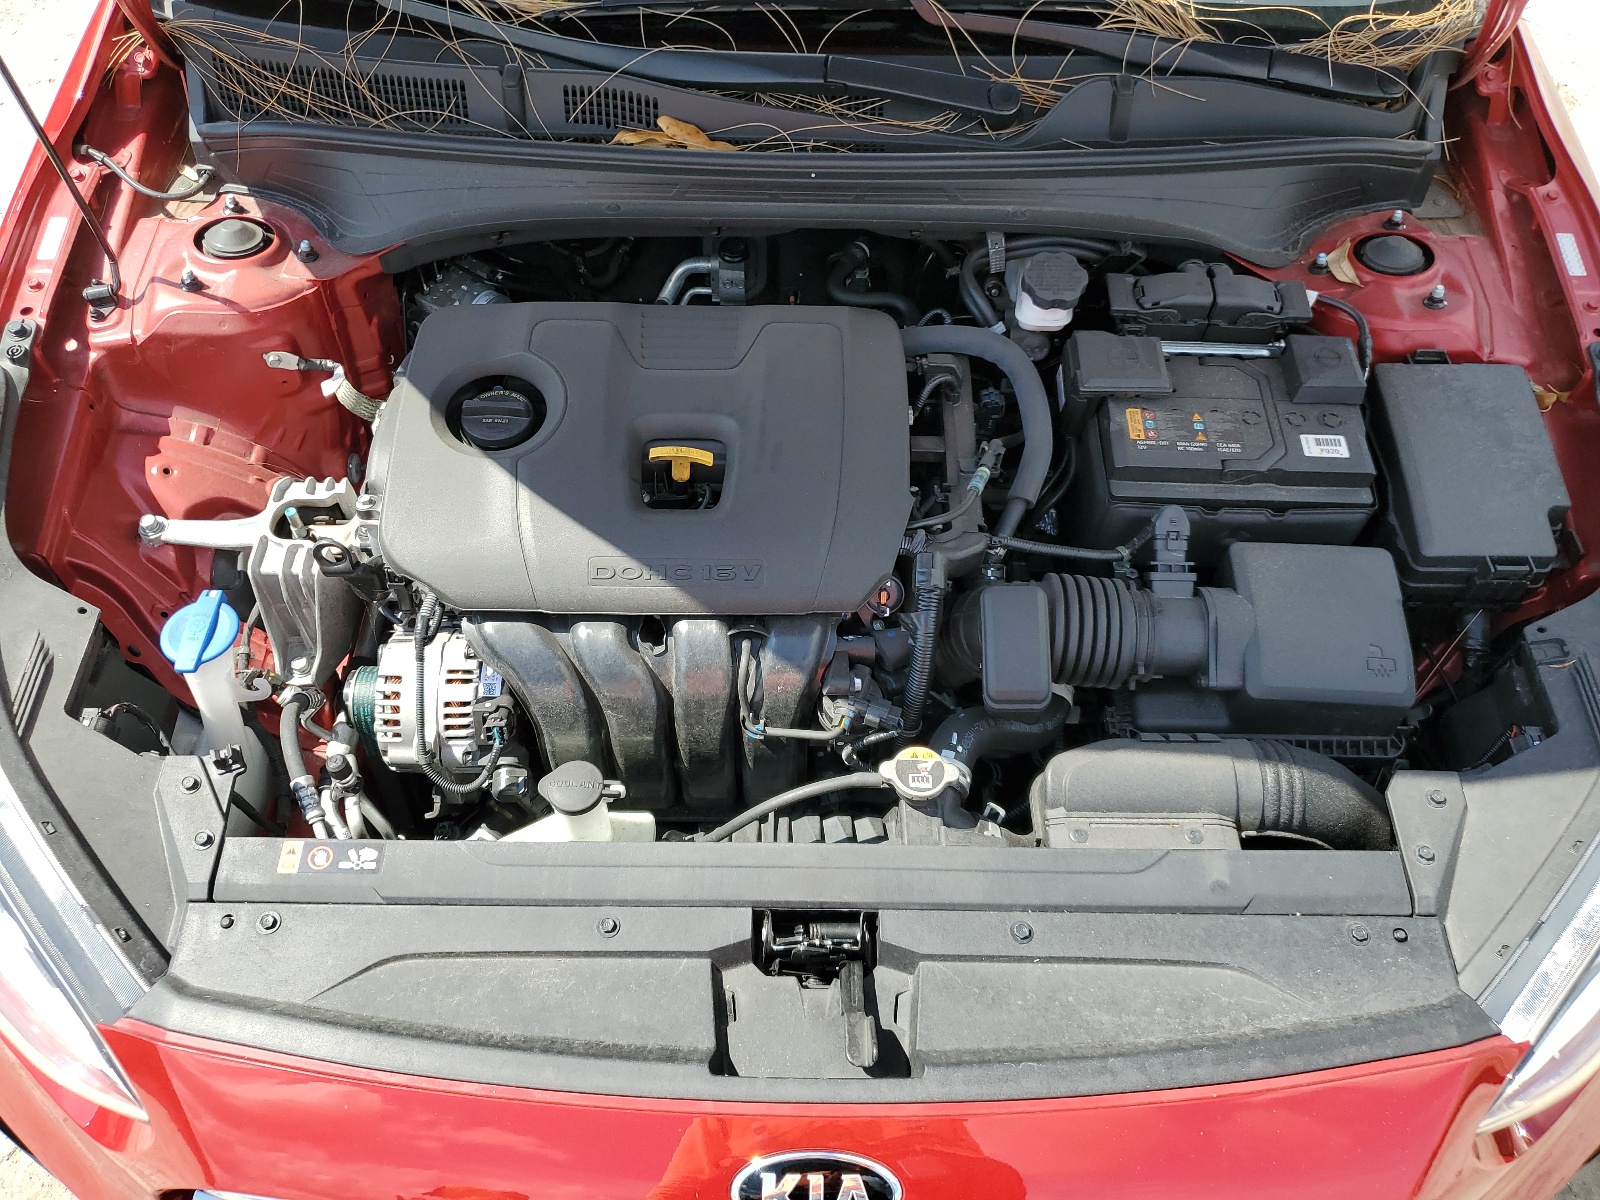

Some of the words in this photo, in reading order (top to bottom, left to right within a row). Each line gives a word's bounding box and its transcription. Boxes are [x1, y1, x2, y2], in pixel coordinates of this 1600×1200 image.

[591, 564, 693, 581] DOHC
[702, 564, 762, 582] 16V
[549, 780, 602, 790] COOLANT
[760, 1172, 869, 1200] KIA
